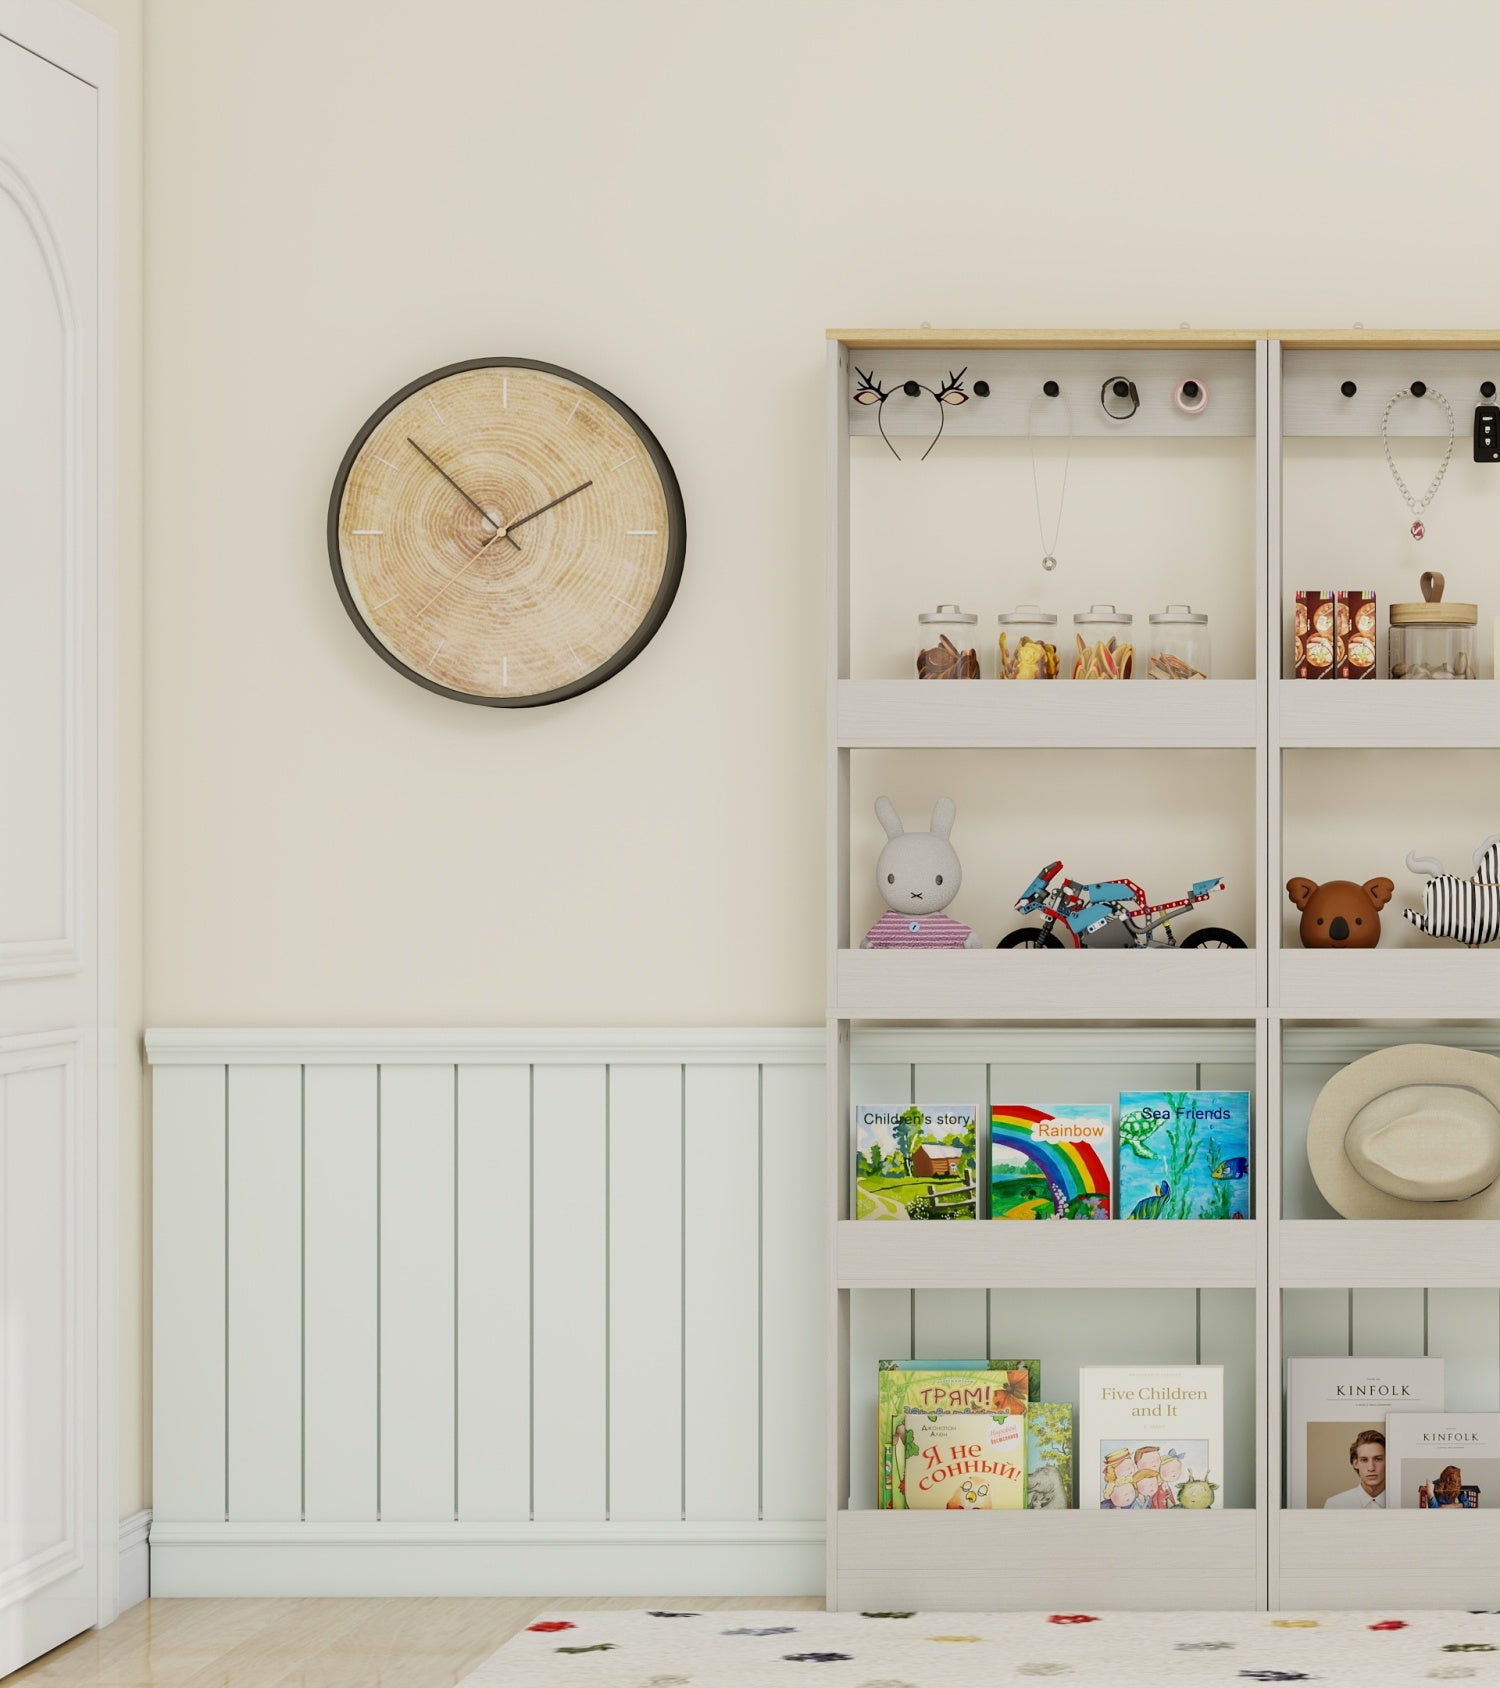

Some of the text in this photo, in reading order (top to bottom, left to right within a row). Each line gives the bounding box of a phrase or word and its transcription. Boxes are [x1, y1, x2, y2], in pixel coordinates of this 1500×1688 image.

[864, 1112, 970, 1128] Children's story
[1141, 1107, 1231, 1120] Sea Friends
[1038, 1124, 1104, 1137] Rainbow
[920, 1386, 991, 1406] ТРЯМ!
[1102, 1387, 1208, 1400] Five Children
[1336, 1385, 1411, 1396] KINFOLK
[1131, 1403, 1178, 1417] and It
[1423, 1433, 1479, 1442] KINFOLK
[922, 1444, 982, 1470] Я не
[918, 1460, 1022, 1491] сонный!
